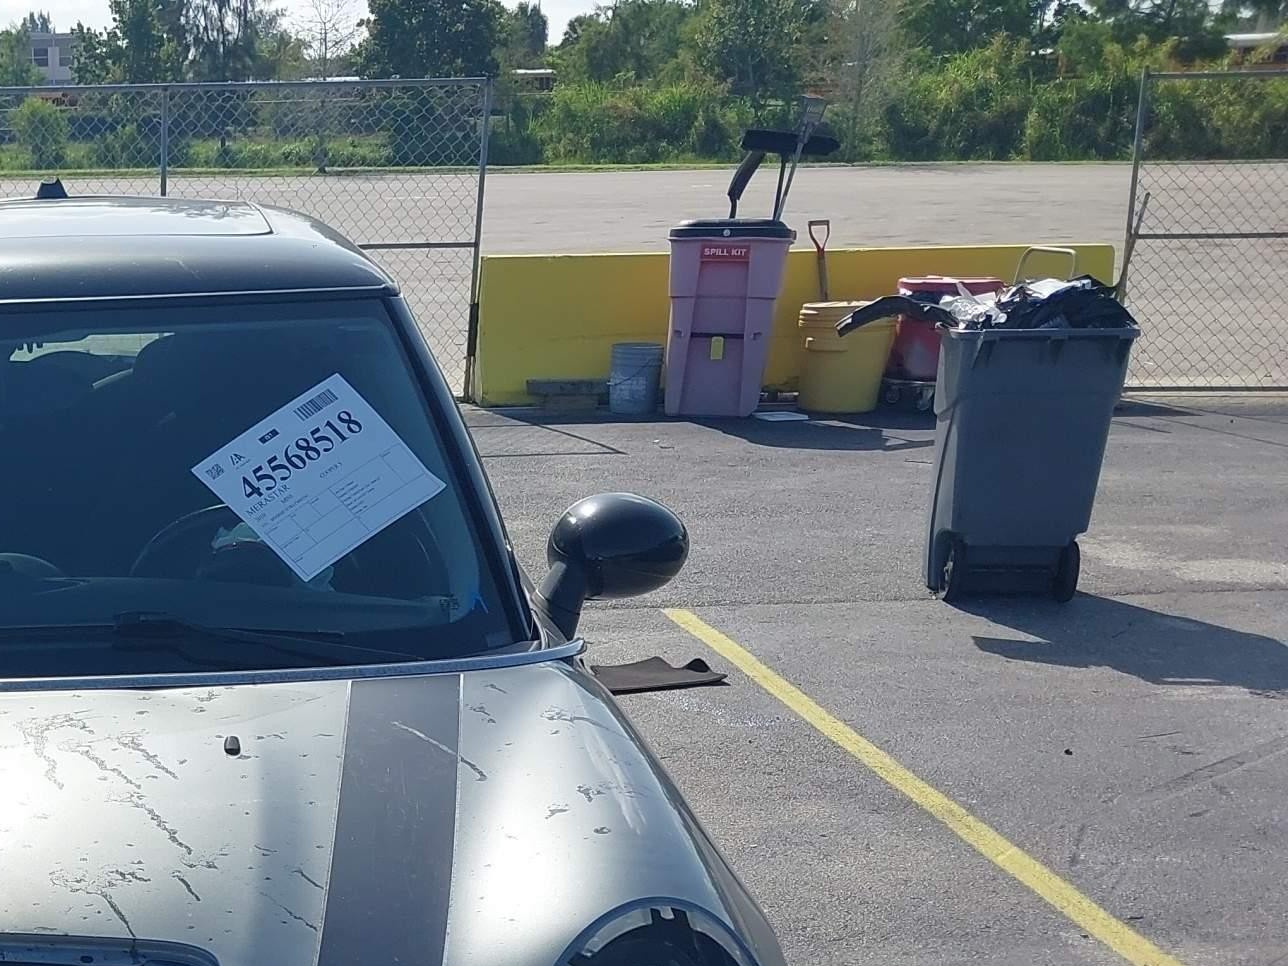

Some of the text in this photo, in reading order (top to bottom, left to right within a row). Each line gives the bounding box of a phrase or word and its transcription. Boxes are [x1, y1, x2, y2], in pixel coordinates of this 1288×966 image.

[704, 247, 747, 256] SPILL KIT
[241, 410, 363, 499] 45568518
[245, 484, 290, 516] MERASTAR
